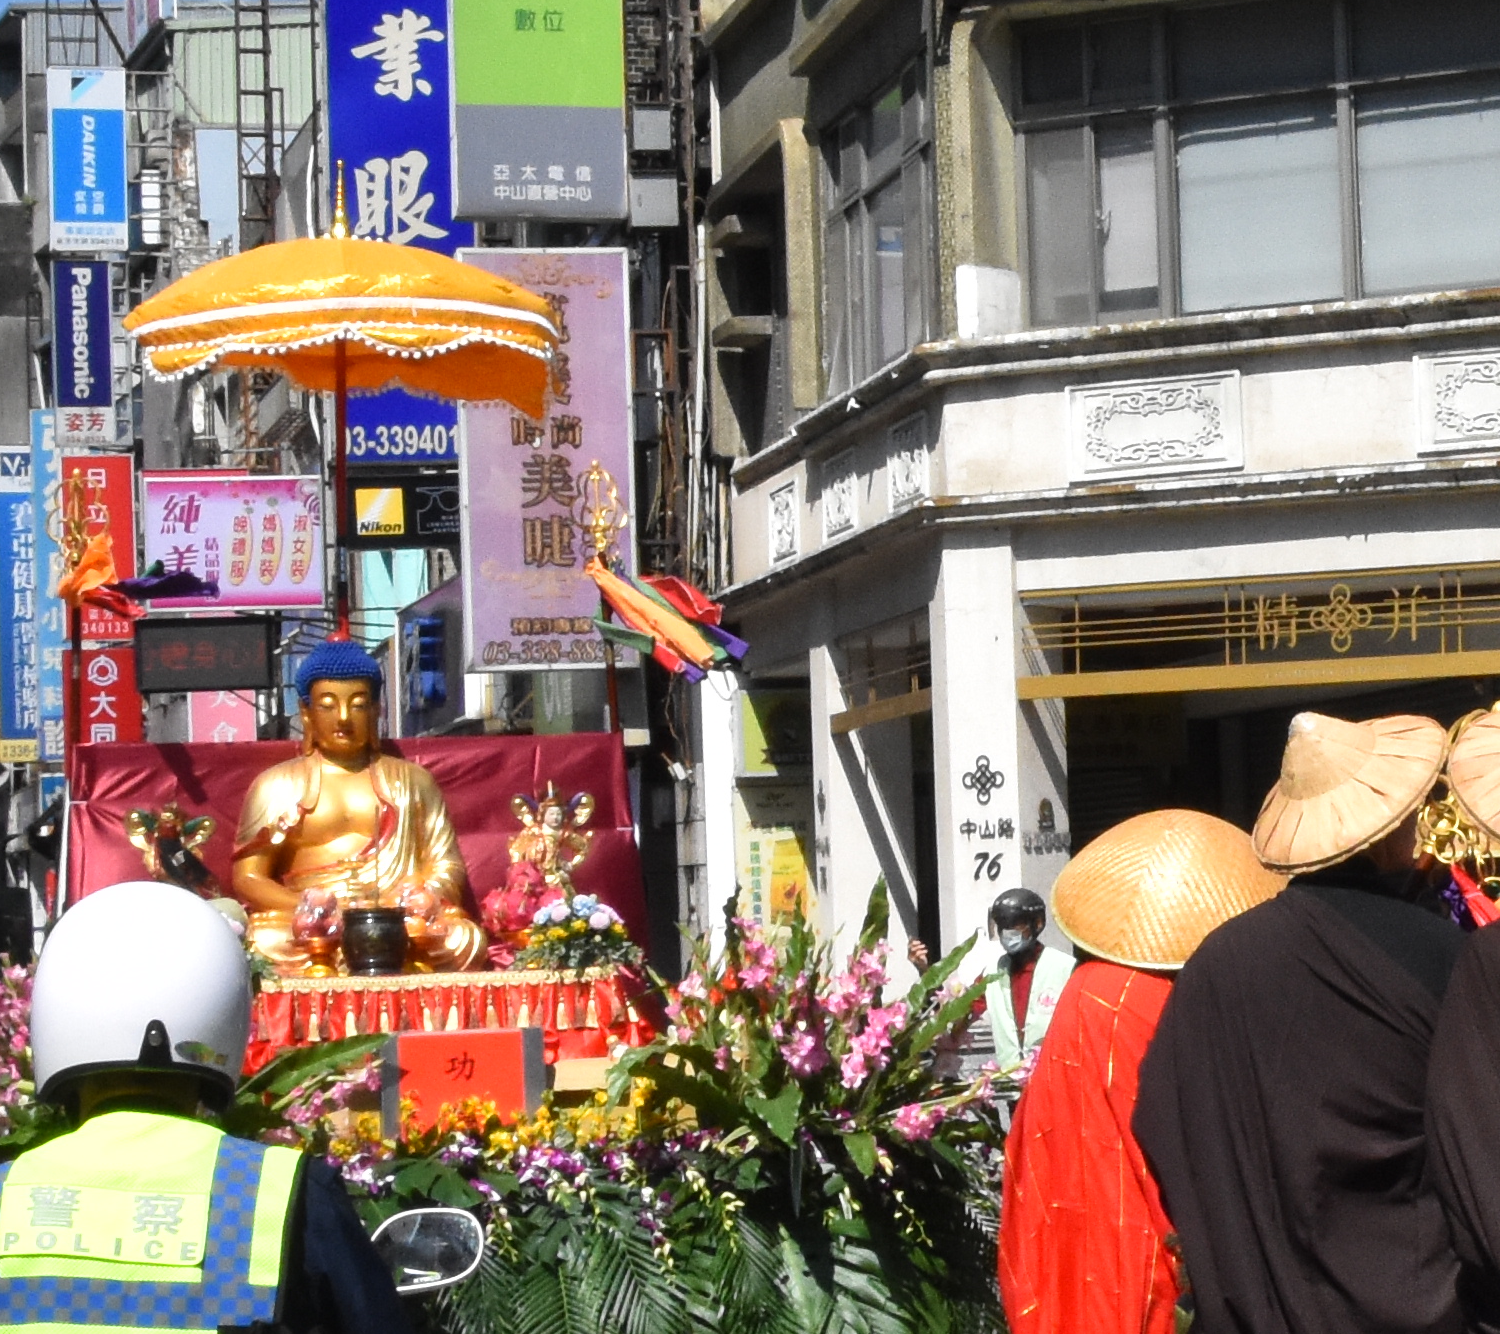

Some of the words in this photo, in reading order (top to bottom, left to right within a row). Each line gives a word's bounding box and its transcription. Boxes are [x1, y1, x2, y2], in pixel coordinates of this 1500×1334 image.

[514, 8, 566, 33] 數位
[81, 114, 97, 189] DAIKIN
[493, 164, 593, 182] 亞太電信
[492, 183, 593, 203] 中山直營中心
[70, 266, 93, 400] Panasonic
[510, 414, 583, 449] 時尚
[88, 468, 108, 524] 日立
[521, 453, 577, 569] 美睫
[230, 515, 249, 580] 晚禮服
[258, 514, 278, 579] 媽媽裝
[290, 515, 309, 580] 淑女裝
[358, 521, 403, 534] Nikon
[90, 691, 118, 744] 大同
[959, 817, 1015, 843] 中山路
[974, 851, 1004, 881] 76
[446, 1053, 475, 1081] 功
[26, 1185, 185, 1237] 警察
[3, 1231, 199, 1262] POLICE
